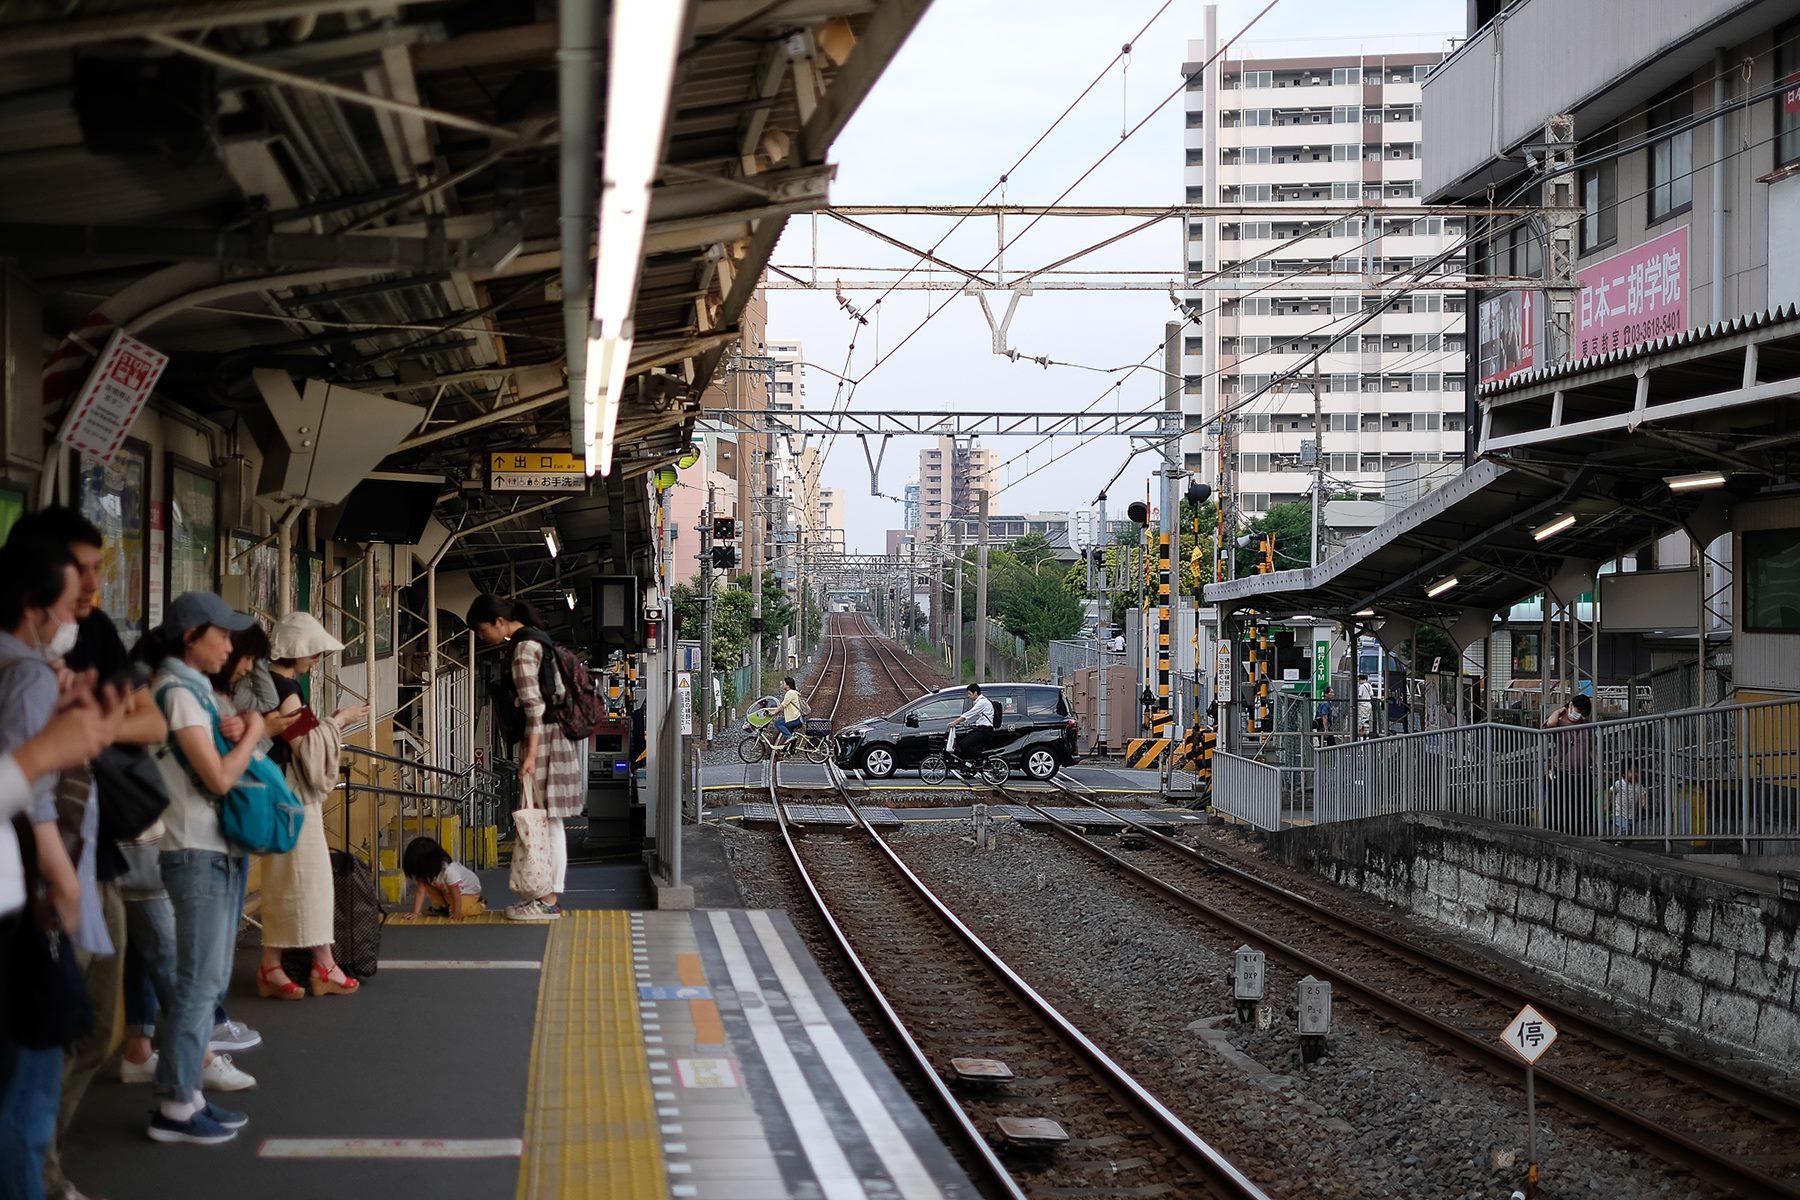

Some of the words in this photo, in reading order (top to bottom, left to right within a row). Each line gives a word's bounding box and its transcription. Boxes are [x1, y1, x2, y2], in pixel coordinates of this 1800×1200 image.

[1581, 247, 1680, 331] 日本二胡学院
[1631, 310, 1680, 344] 03-3618-5401
[514, 455, 552, 468] 出口
[1517, 1021, 1545, 1048] 停
